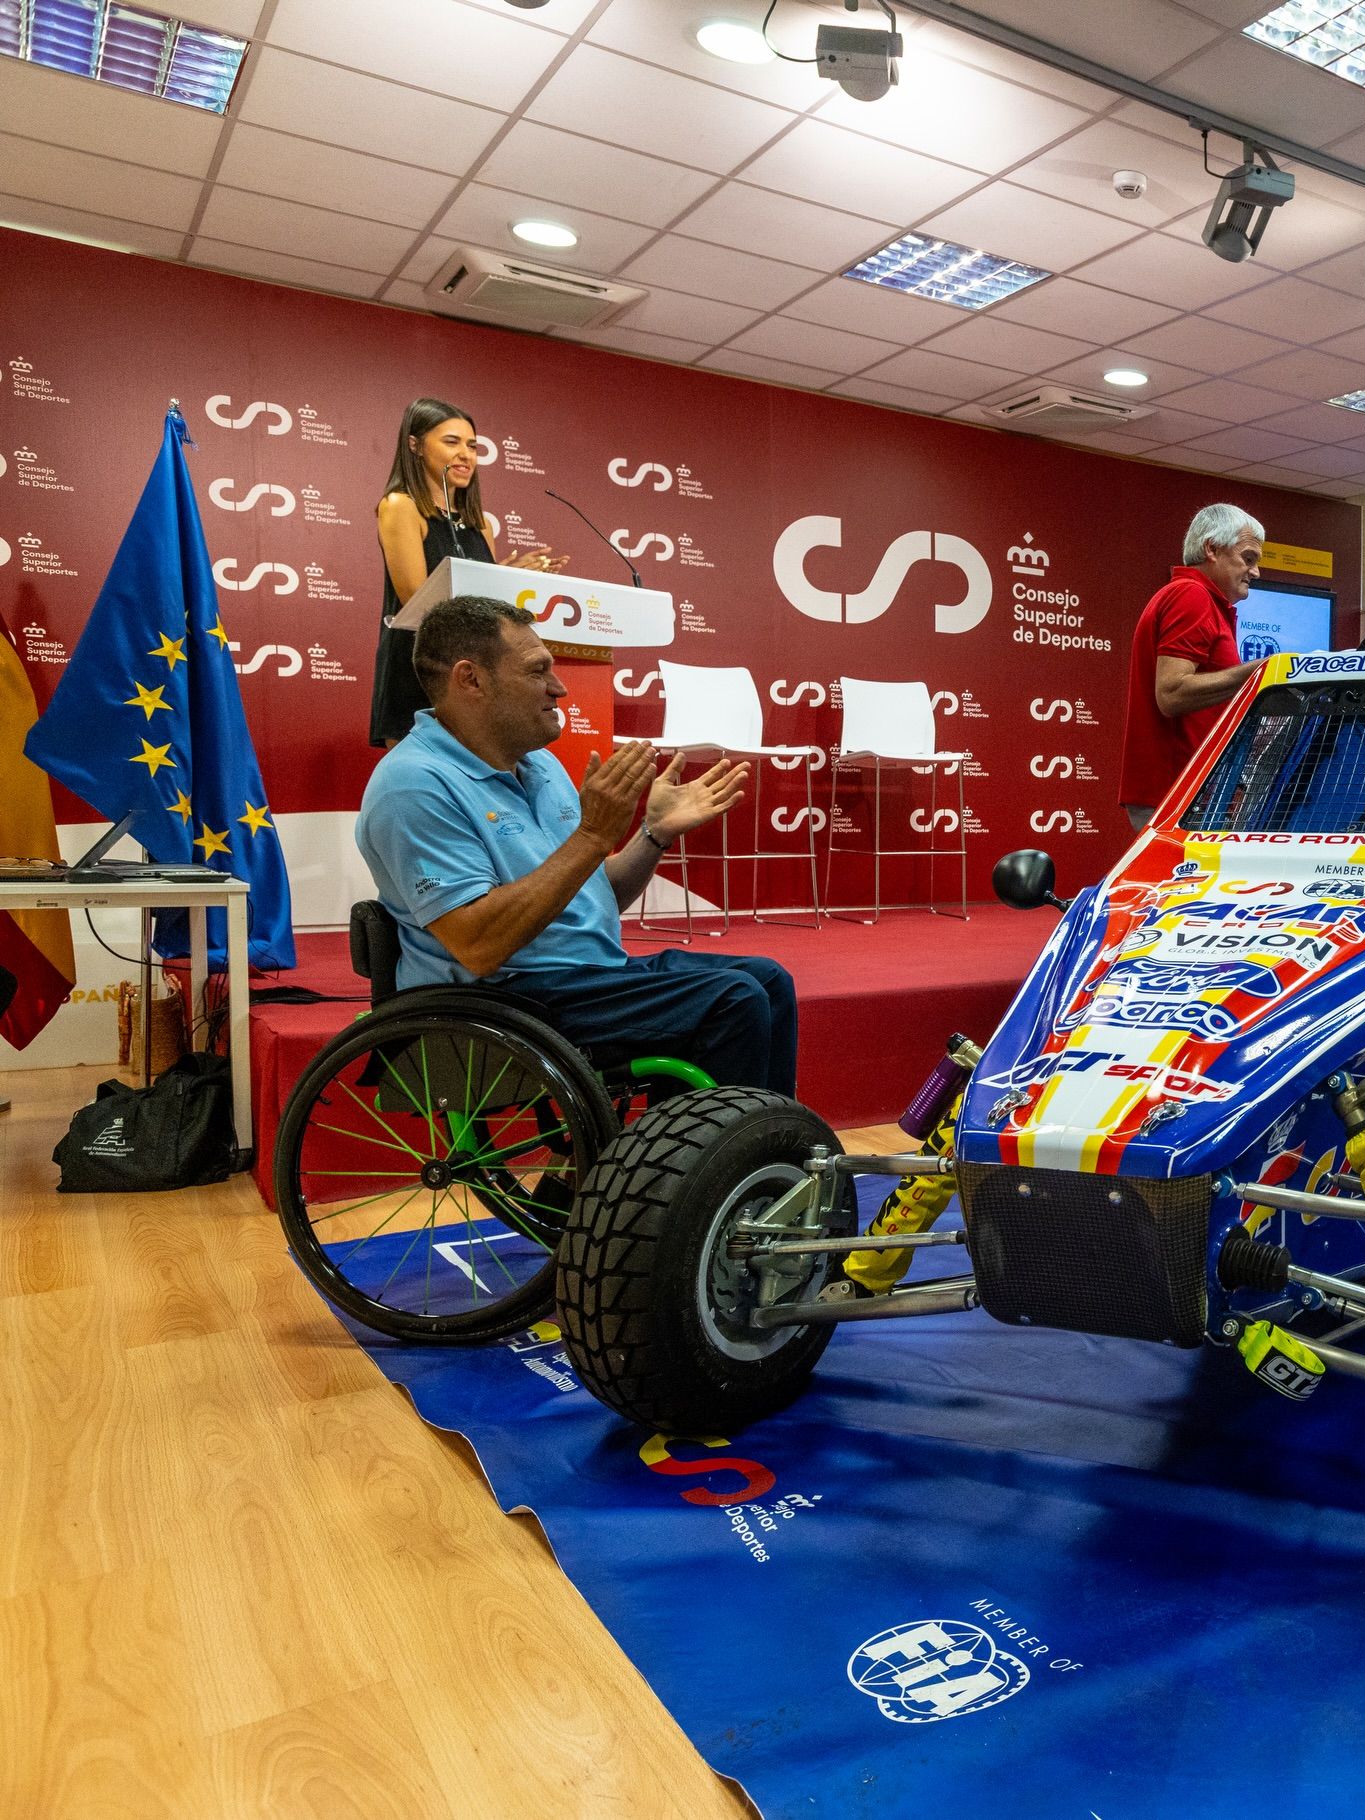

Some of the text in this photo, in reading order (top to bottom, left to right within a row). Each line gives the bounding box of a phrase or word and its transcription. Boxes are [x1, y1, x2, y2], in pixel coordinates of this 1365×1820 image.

[13, 374, 51, 386] Consejo
[14, 382, 54, 393] Superior
[28, 391, 70, 403] Deportes
[301, 420, 332, 430] Consejo
[301, 427, 334, 437] Superior
[314, 435, 348, 446] Deportes
[505, 451, 532, 460] Consejo
[505, 457, 533, 466] Superior
[18, 463, 55, 475] Consejo
[515, 465, 545, 475] Deportes
[18, 471, 58, 482] Superior
[32, 480, 74, 492] Deportes
[678, 478, 701, 487] Consejo
[679, 484, 703, 493] Superior
[687, 490, 713, 500] Deportes
[304, 500, 335, 510] Consejo
[305, 507, 337, 518] Superior
[316, 515, 351, 525] Deportes
[507, 526, 534, 535] Consejo
[508, 532, 536, 541] Superior
[517, 539, 547, 548] Deportes
[22, 550, 59, 560] Consejo
[680, 547, 703, 555] Consejo
[680, 553, 705, 561] Superior
[22, 558, 62, 568] Superior
[689, 559, 714, 568] Deportes
[37, 566, 78, 576] Deportes
[307, 578, 338, 588] Consejo
[308, 585, 340, 594] Superior
[319, 592, 354, 601] Deportes
[1012, 583, 1080, 609] Consejo
[588, 611, 611, 620] Consejo
[681, 613, 704, 622] Consejo
[1013, 604, 1084, 628] Superior
[589, 618, 613, 626] Superior
[1241, 621, 1281, 633] MEMBER OF
[597, 625, 623, 635] Deportes
[690, 626, 716, 634] Deportes
[26, 640, 64, 649] Consejo
[1013, 627, 1112, 652] de Deportes
[27, 647, 66, 656] Superior
[41, 656, 71, 664] Depor
[310, 659, 342, 668] Consejo
[311, 666, 343, 675] Superior
[322, 673, 357, 681] Deportes
[1188, 833, 1293, 844] MARC
[1314, 864, 1365, 876] MEMBER
[1305, 881, 1365, 897] FIA
[1176, 932, 1335, 963] VISION
[725, 1506, 770, 1563] Deportes
[968, 1597, 1085, 1676] MEMBER OF
[863, 1621, 1006, 1717] FIA
